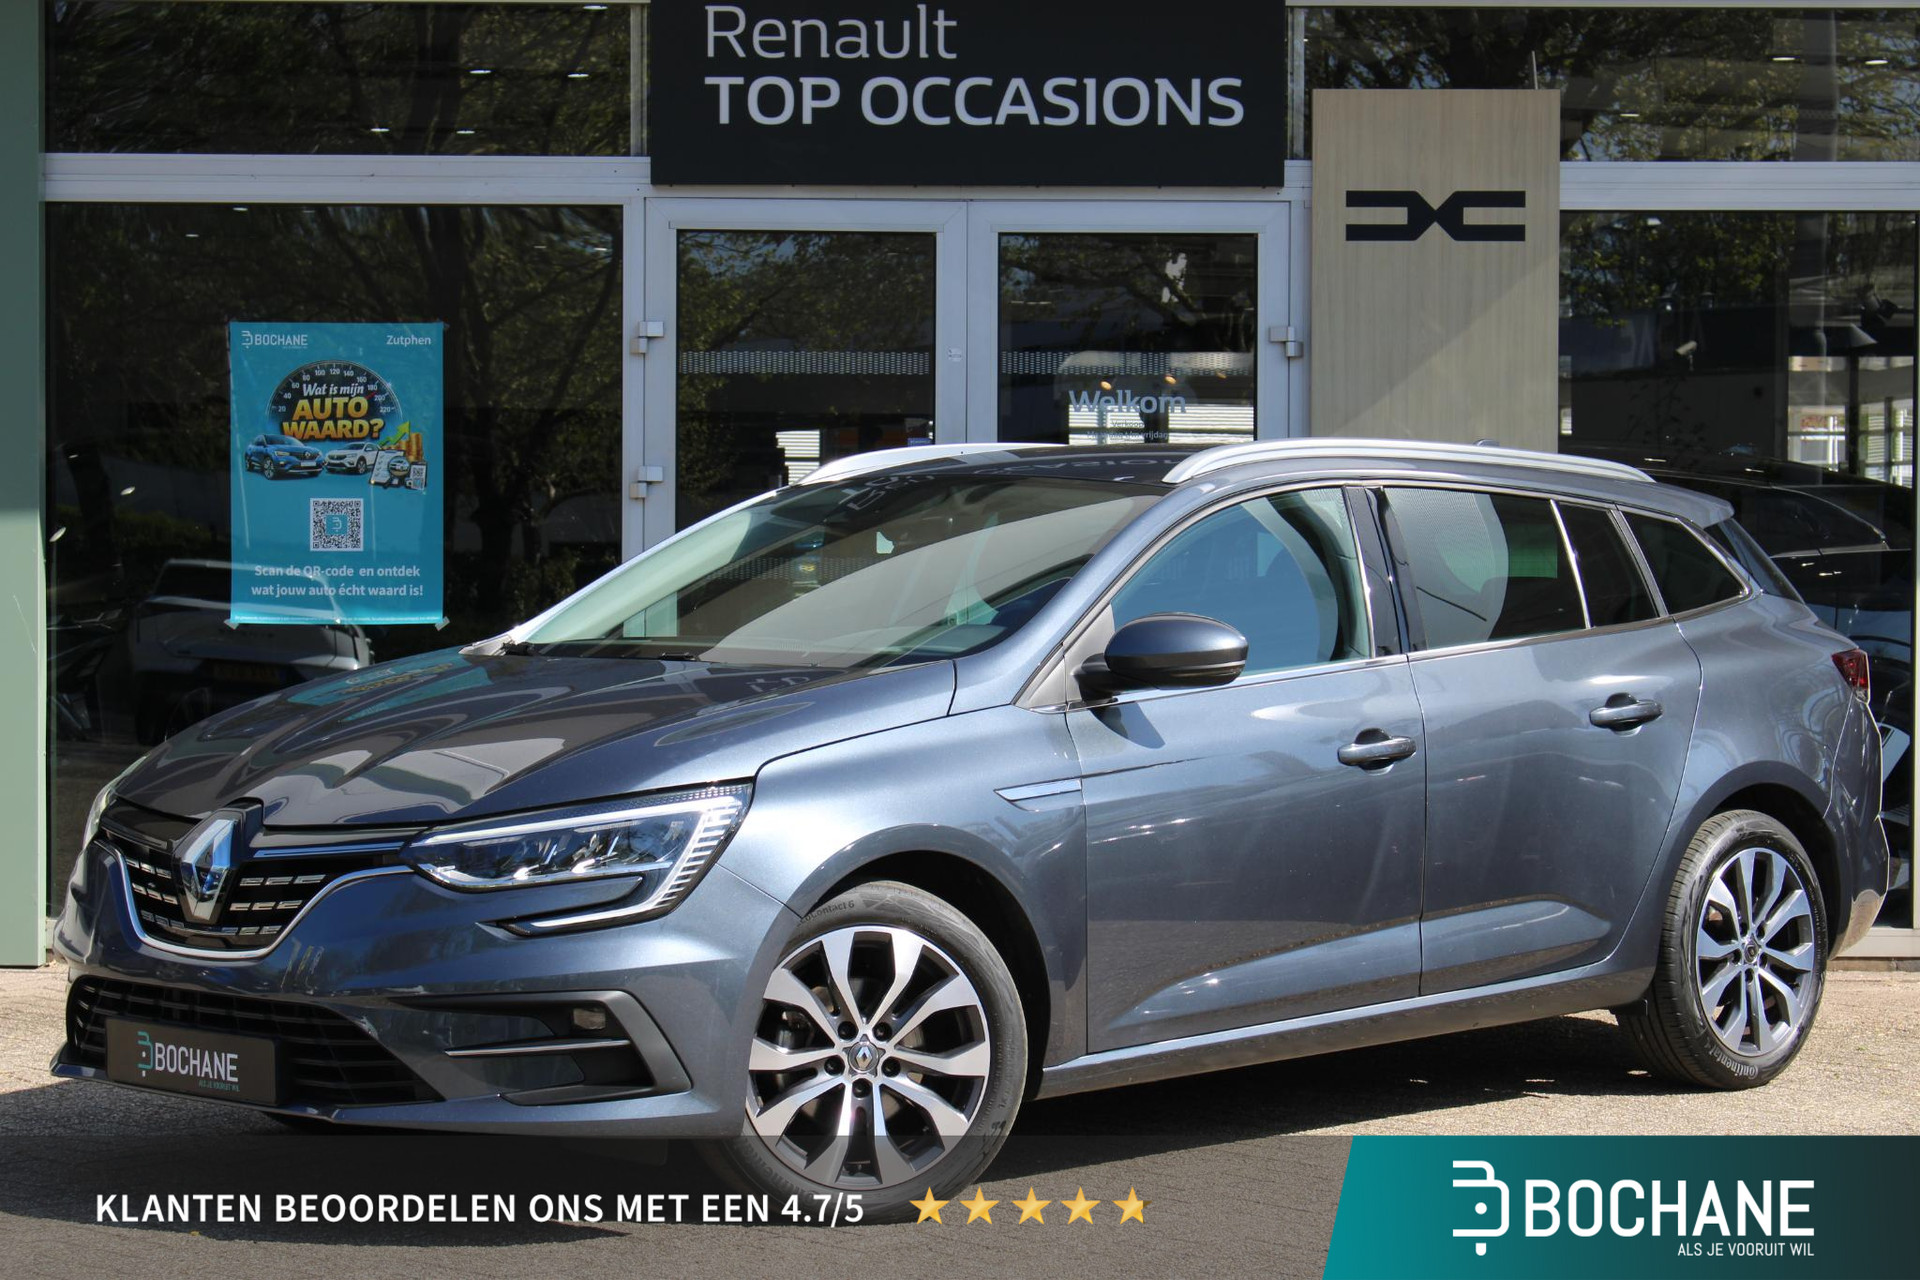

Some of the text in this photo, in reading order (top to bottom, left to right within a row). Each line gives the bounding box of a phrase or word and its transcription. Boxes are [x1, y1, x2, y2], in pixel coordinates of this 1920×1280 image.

[705, 4, 956, 59] Renault
[704, 76, 1244, 127] TOP OCCASIONS
[254, 334, 308, 346] BOCHANE
[386, 335, 432, 347] Zutphen
[343, 369, 355, 377] 140
[302, 383, 365, 397] Wat is mijn
[292, 396, 370, 421] AUTO
[1068, 390, 1187, 414] Welkom
[282, 418, 385, 440] WAARD?
[254, 565, 420, 578] Scan de QR-code en ontdek
[251, 583, 424, 598] wat jouw auto écht waard is!
[155, 1042, 239, 1083] BOCHANE
